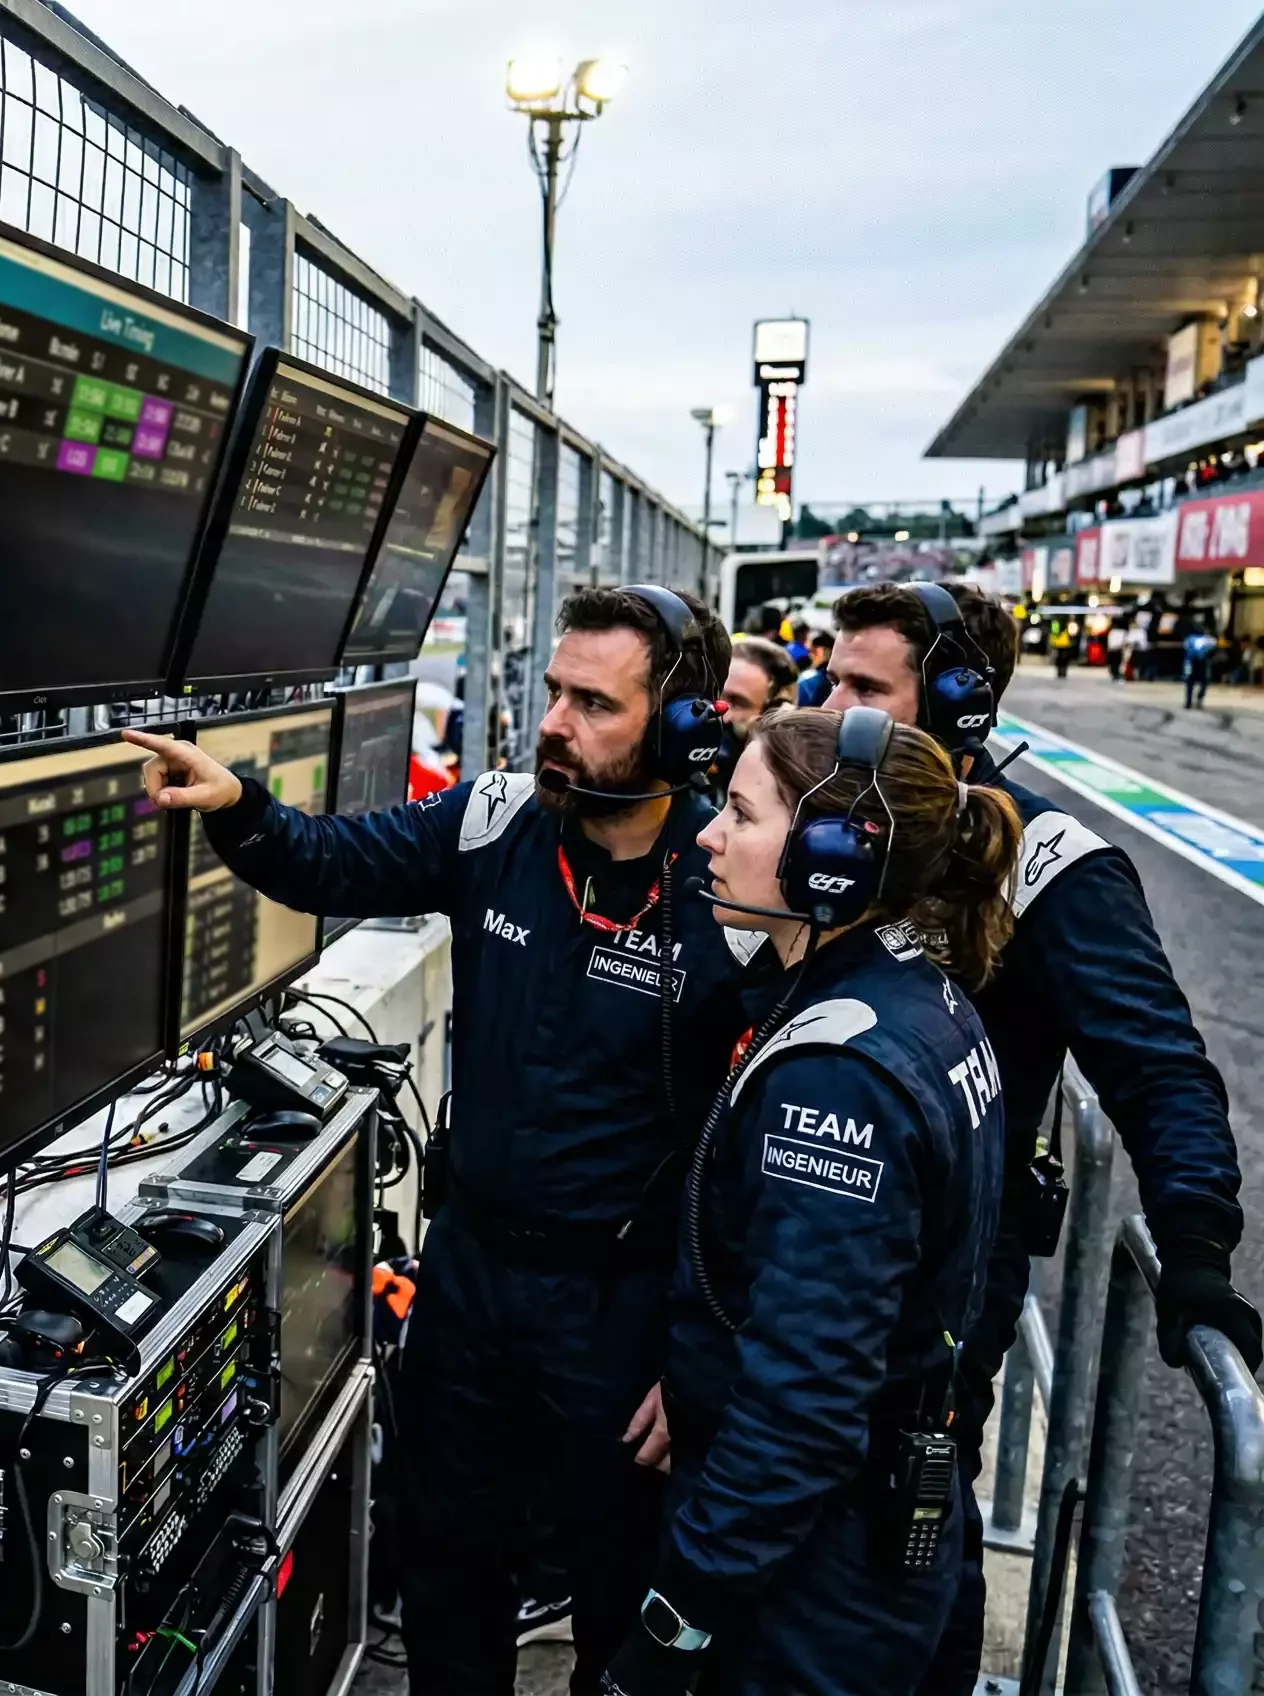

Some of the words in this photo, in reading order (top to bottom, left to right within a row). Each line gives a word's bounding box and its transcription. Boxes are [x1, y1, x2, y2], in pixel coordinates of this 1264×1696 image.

[100, 309, 122, 336] Live
[123, 316, 154, 352] Timing
[483, 908, 531, 947] Max
[780, 1103, 874, 1149] TEAM
[767, 1146, 873, 1189] INGENIEUR
